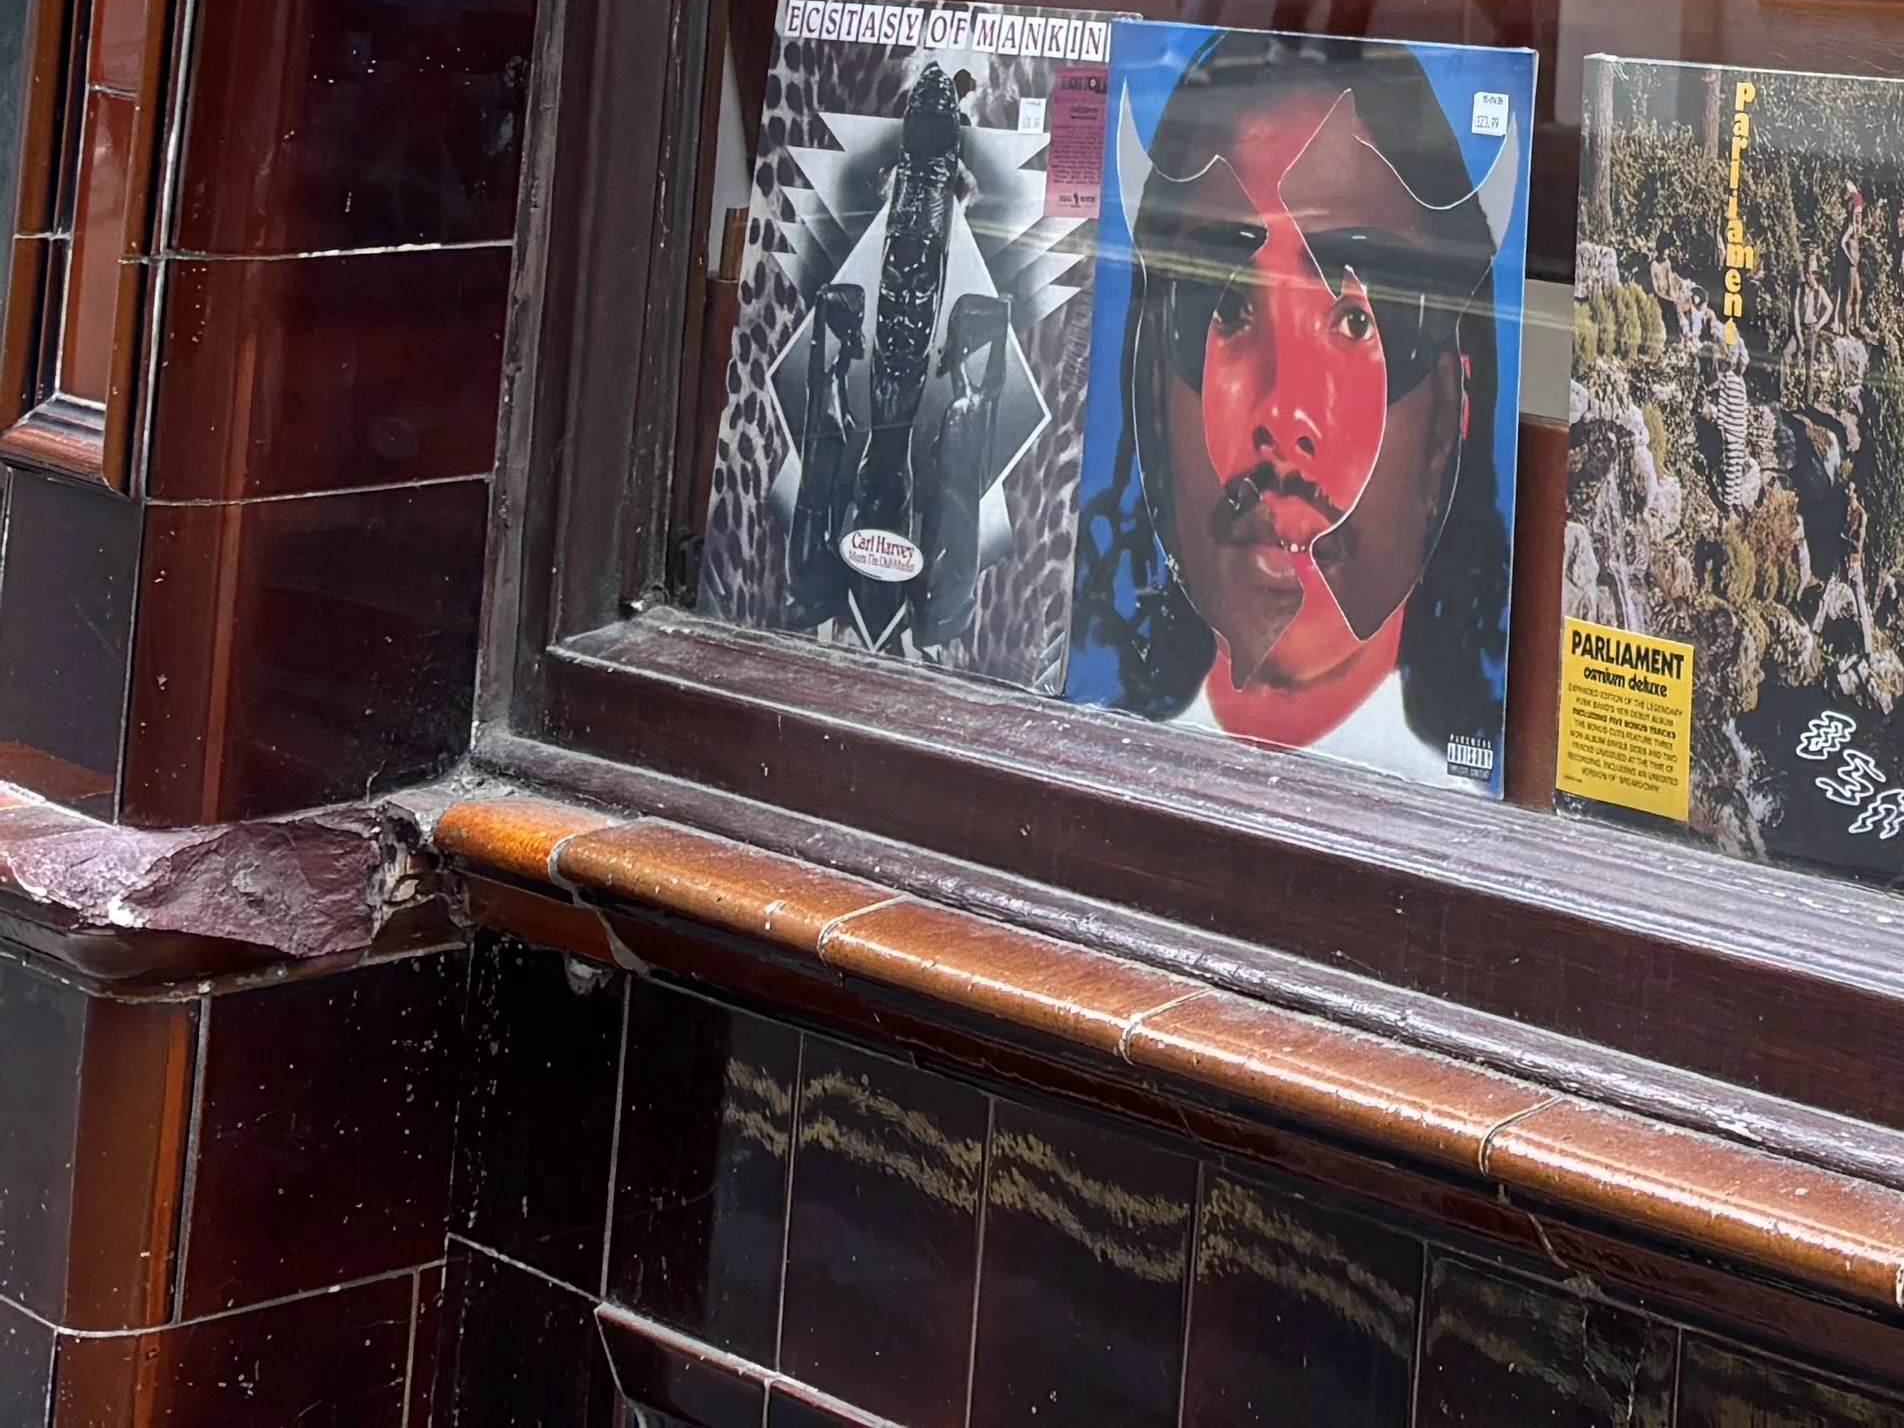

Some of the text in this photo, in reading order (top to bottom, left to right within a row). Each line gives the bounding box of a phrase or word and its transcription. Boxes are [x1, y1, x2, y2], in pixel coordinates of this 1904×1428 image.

[788, 5, 919, 41] ECSTASY
[930, 12, 968, 45] OF
[851, 531, 875, 552] Carl
[875, 535, 915, 564] Harvey
[1570, 629, 1685, 680] PARLIAMENT
[1583, 666, 1668, 698] osmium deluxe
